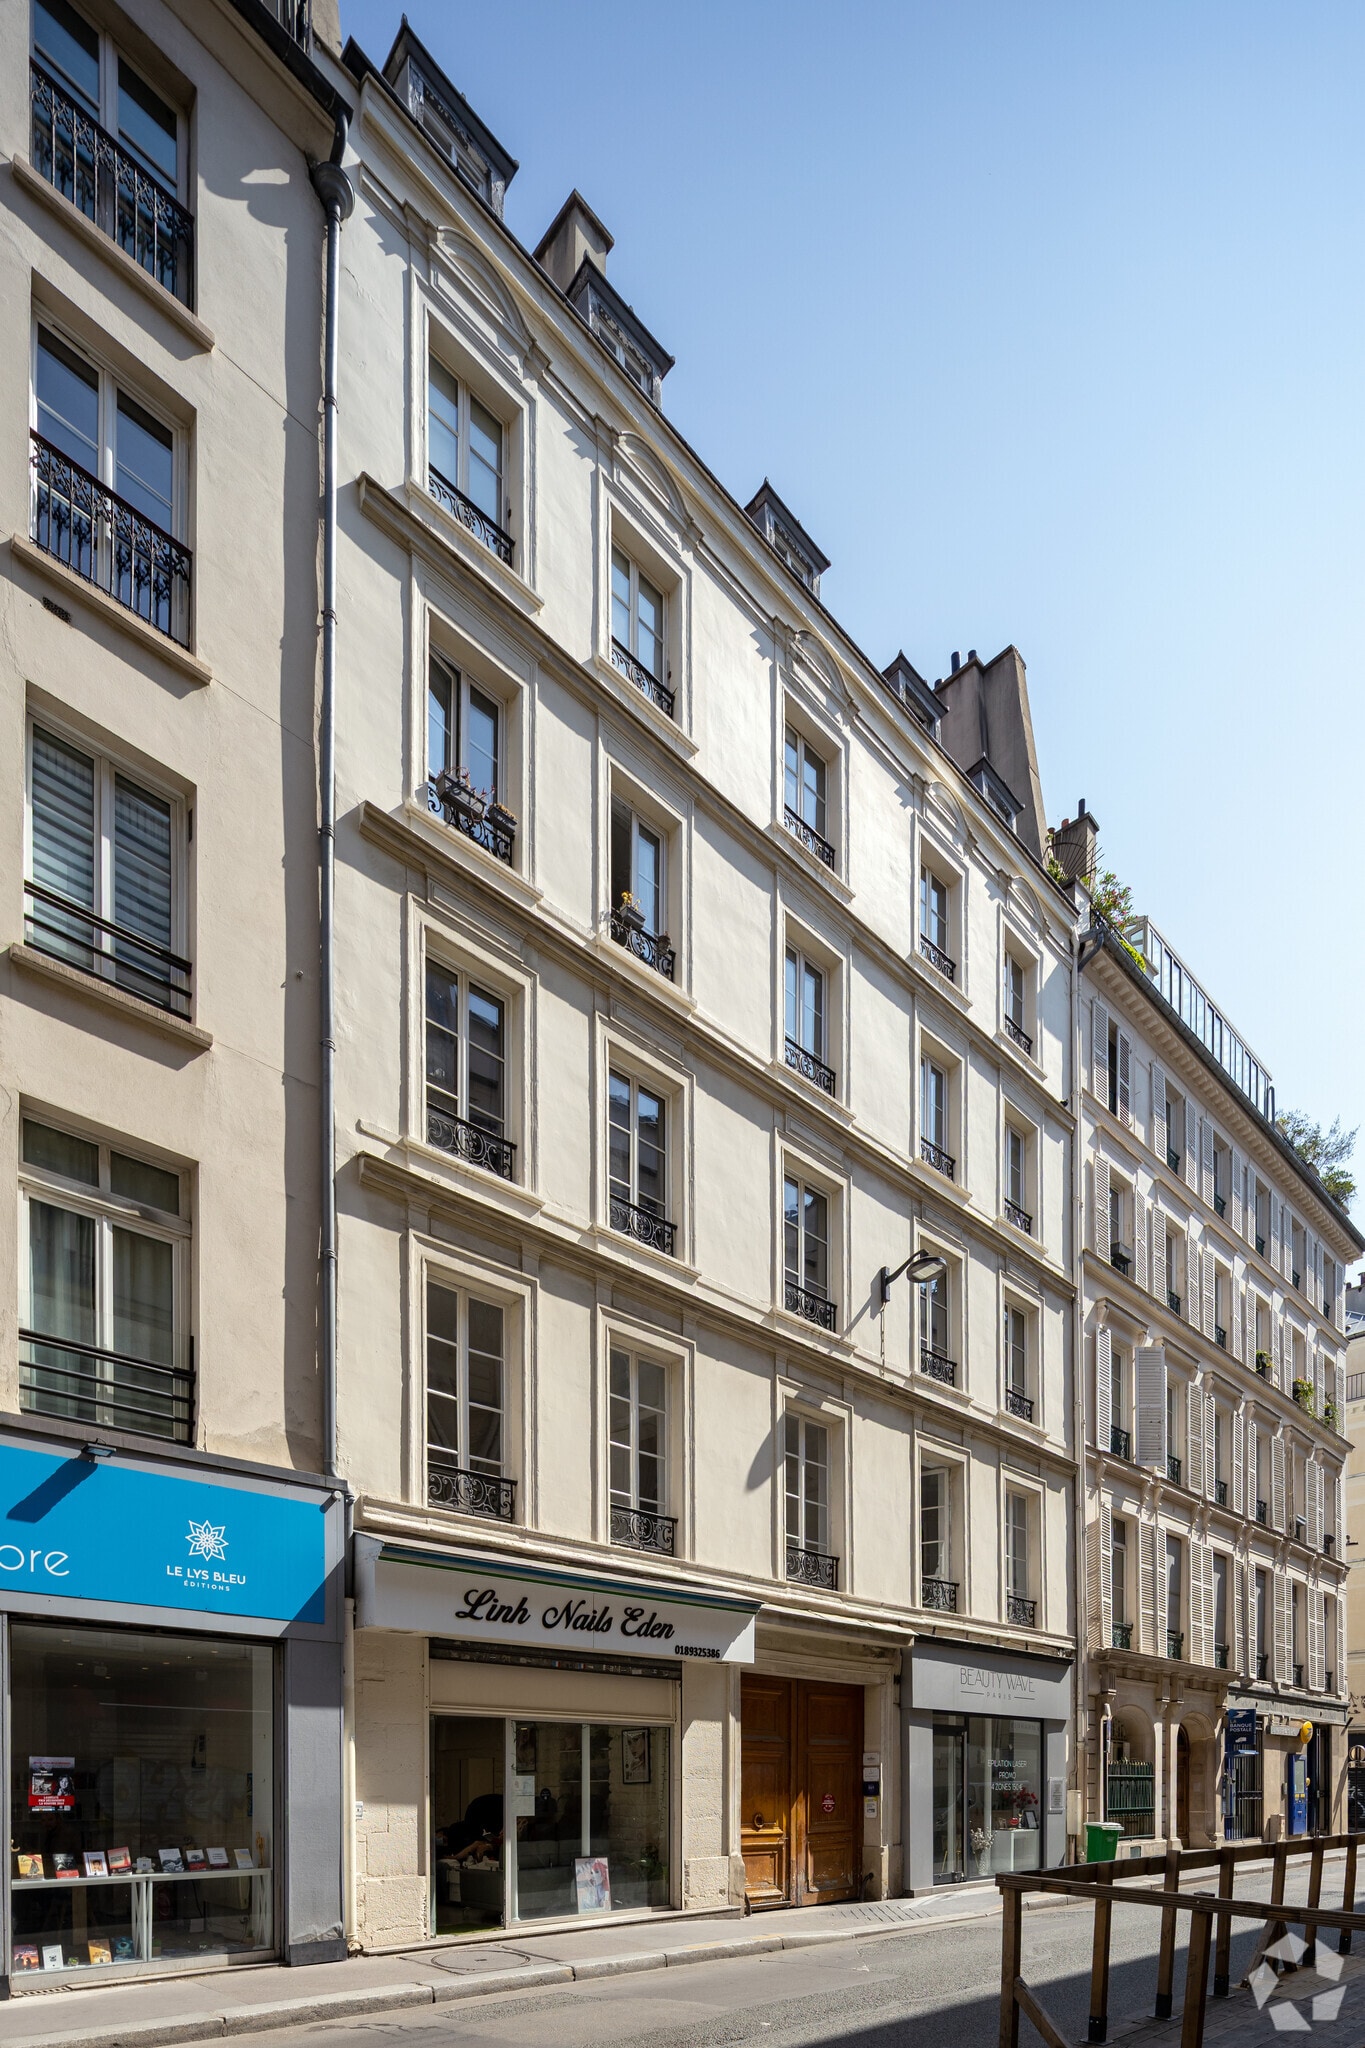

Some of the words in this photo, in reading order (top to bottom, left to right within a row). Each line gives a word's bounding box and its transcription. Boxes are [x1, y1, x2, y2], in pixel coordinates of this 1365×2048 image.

[166, 1564, 183, 1577] LE
[187, 1567, 209, 1580] LYS
[213, 1572, 246, 1585] BLEU
[183, 1579, 231, 1592] ÉDITIONS
[455, 1588, 531, 1625] Linh
[541, 1599, 614, 1633] Nails
[620, 1606, 675, 1640] Eden
[674, 1644, 721, 1659] 0189325386
[960, 1667, 1003, 1689] BEAUTY
[1005, 1672, 1036, 1693] WAVE
[986, 1691, 1012, 1700] PARIS
